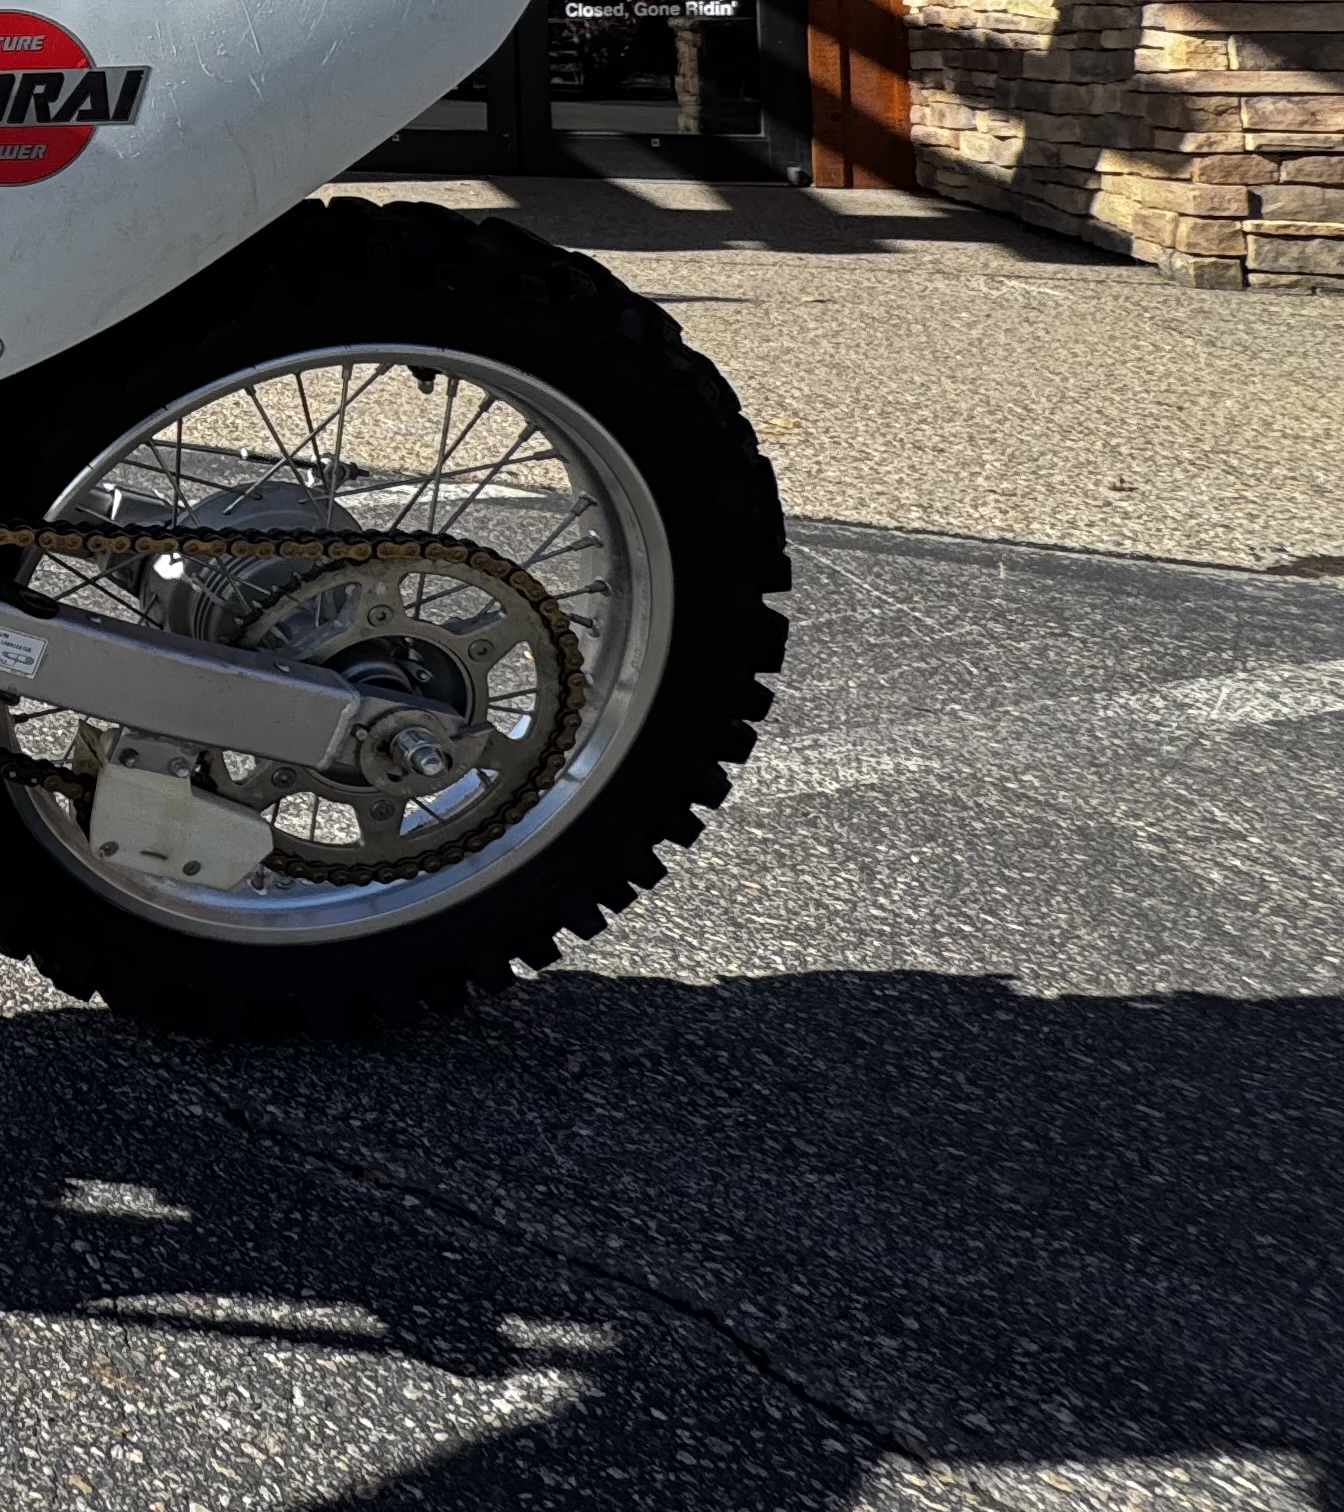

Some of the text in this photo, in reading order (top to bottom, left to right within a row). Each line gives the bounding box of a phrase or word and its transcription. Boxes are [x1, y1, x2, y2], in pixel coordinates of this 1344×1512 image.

[565, 0, 738, 18] Closed, Gone Ridin'
